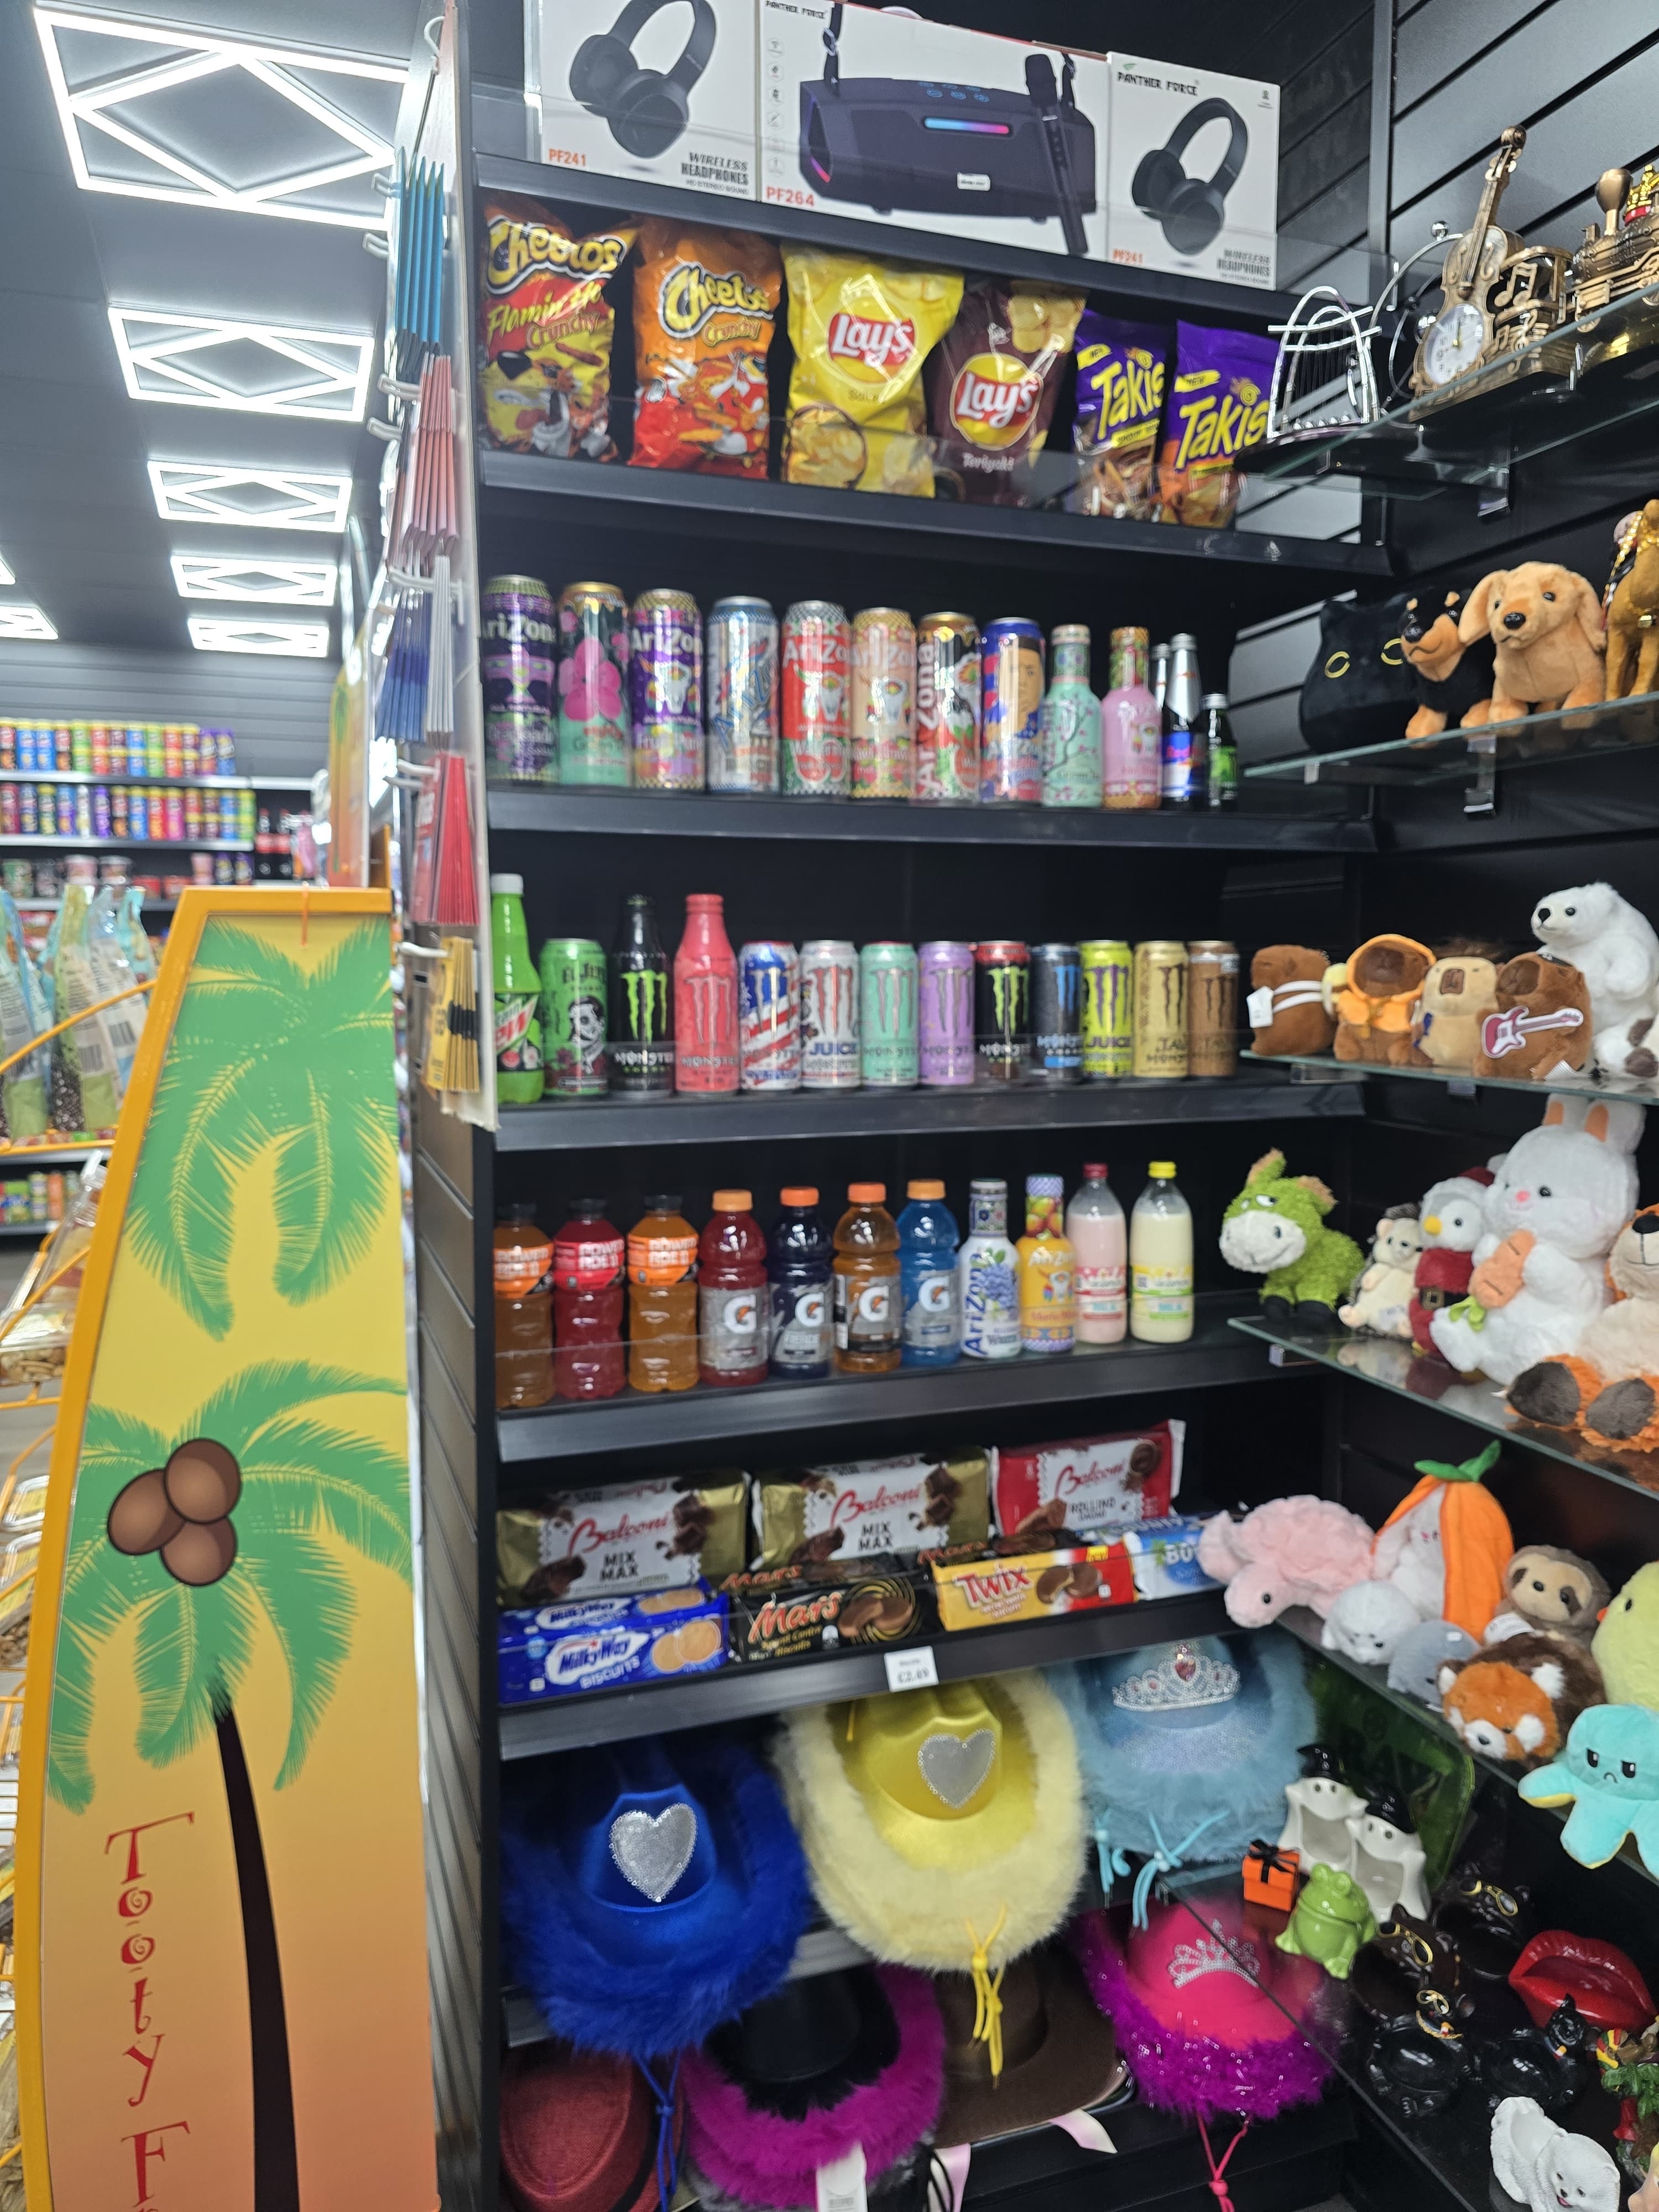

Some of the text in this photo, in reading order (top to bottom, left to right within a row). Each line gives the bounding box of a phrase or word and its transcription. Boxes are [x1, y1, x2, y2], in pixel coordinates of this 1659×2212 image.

[1117, 71, 1198, 97] PANTHER FORCE
[549, 148, 587, 168] PF241
[681, 162, 749, 186] HEADPHONES
[689, 152, 749, 172] WIRELESS
[766, 185, 815, 207] PF264
[662, 265, 772, 332] Cheetos
[831, 313, 914, 368] Lay's
[956, 372, 1039, 429] Lay's
[1090, 359, 1165, 441] Takis
[1176, 394, 1270, 469] Takis
[578, 1239, 624, 1257] POWER
[649, 1238, 697, 1252] POWER
[795, 1291, 825, 1328] G
[858, 1286, 889, 1322] G
[919, 1276, 950, 1313] G
[723, 1294, 757, 1334] G
[1055, 1460, 1126, 1498] Balconi
[830, 1485, 922, 1528] Balconi
[567, 1512, 671, 1557] Balconi
[857, 1536, 894, 1551] MAX
[861, 1521, 891, 1536] MIX
[599, 1564, 639, 1580] MAX
[604, 1551, 636, 1566] MIX
[719, 1565, 802, 1592] Mars
[748, 1591, 842, 1645] Mars
[105, 1811, 195, 2212] Tooty F
